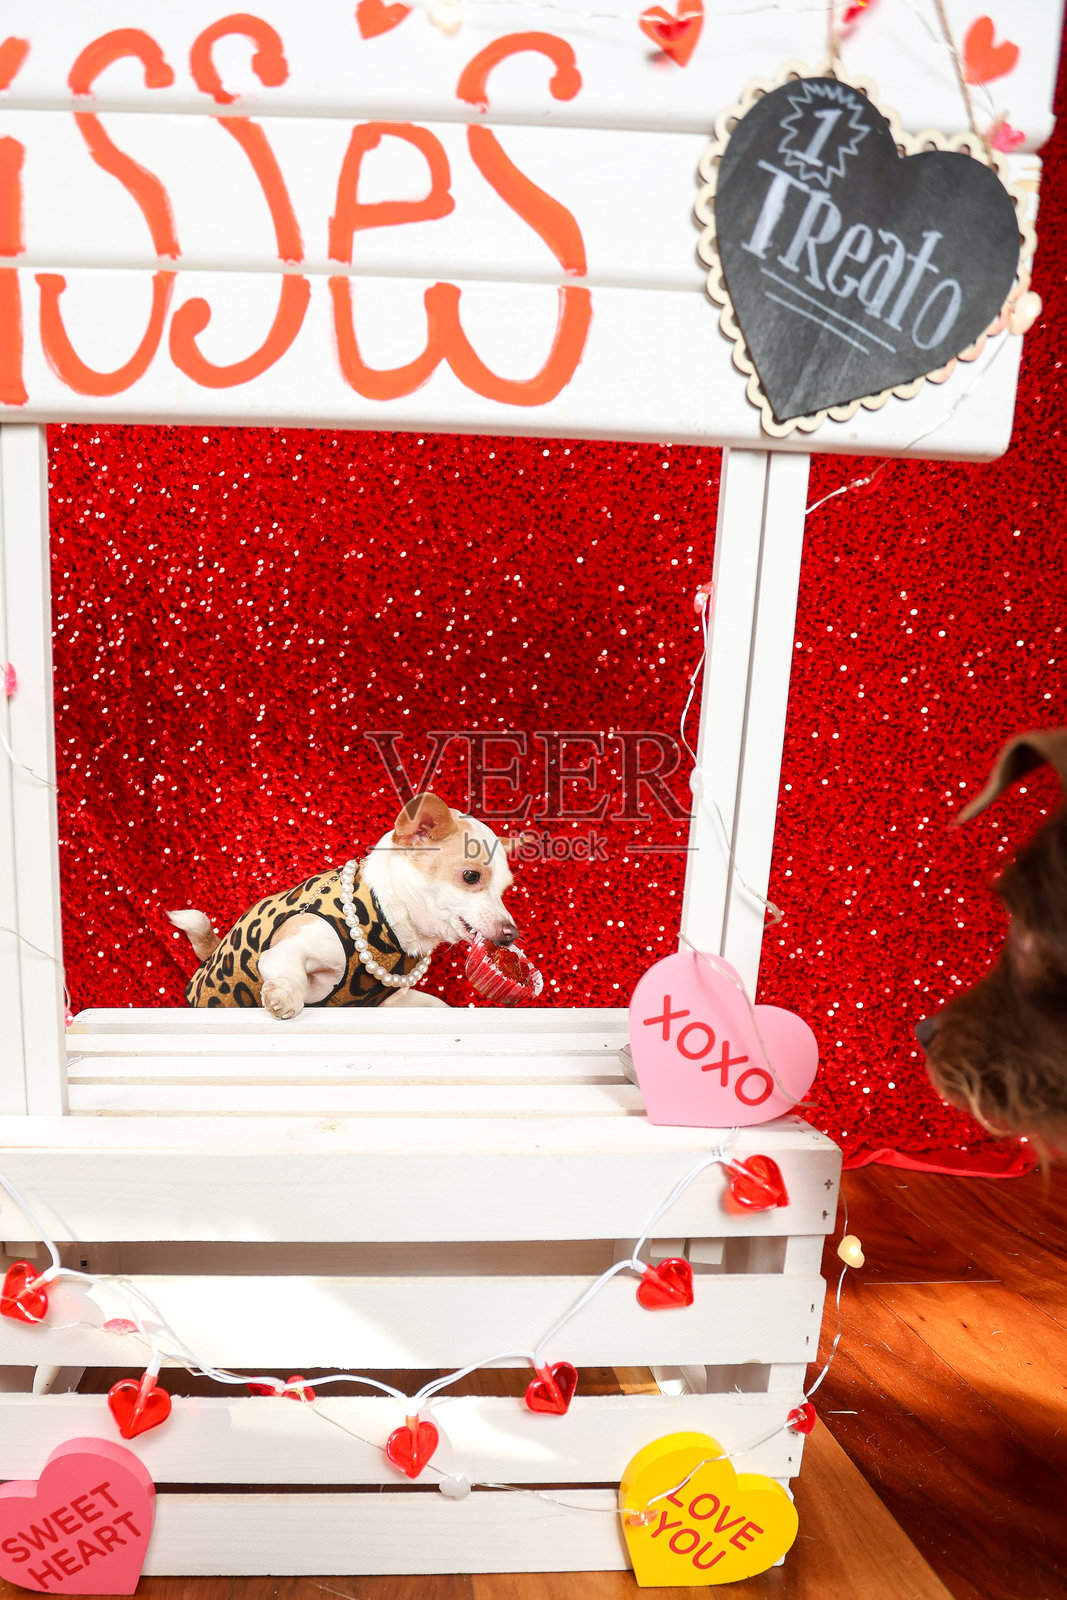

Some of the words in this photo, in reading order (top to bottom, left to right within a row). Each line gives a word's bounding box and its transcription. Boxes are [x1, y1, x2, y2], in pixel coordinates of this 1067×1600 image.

[794, 108, 843, 166] 1
[643, 994, 774, 1106] XOXO
[1, 1481, 118, 1563] SWEET
[27, 1511, 141, 1590] HEART
[651, 1511, 726, 1570] YOU
[666, 1477, 764, 1551] LOVE
